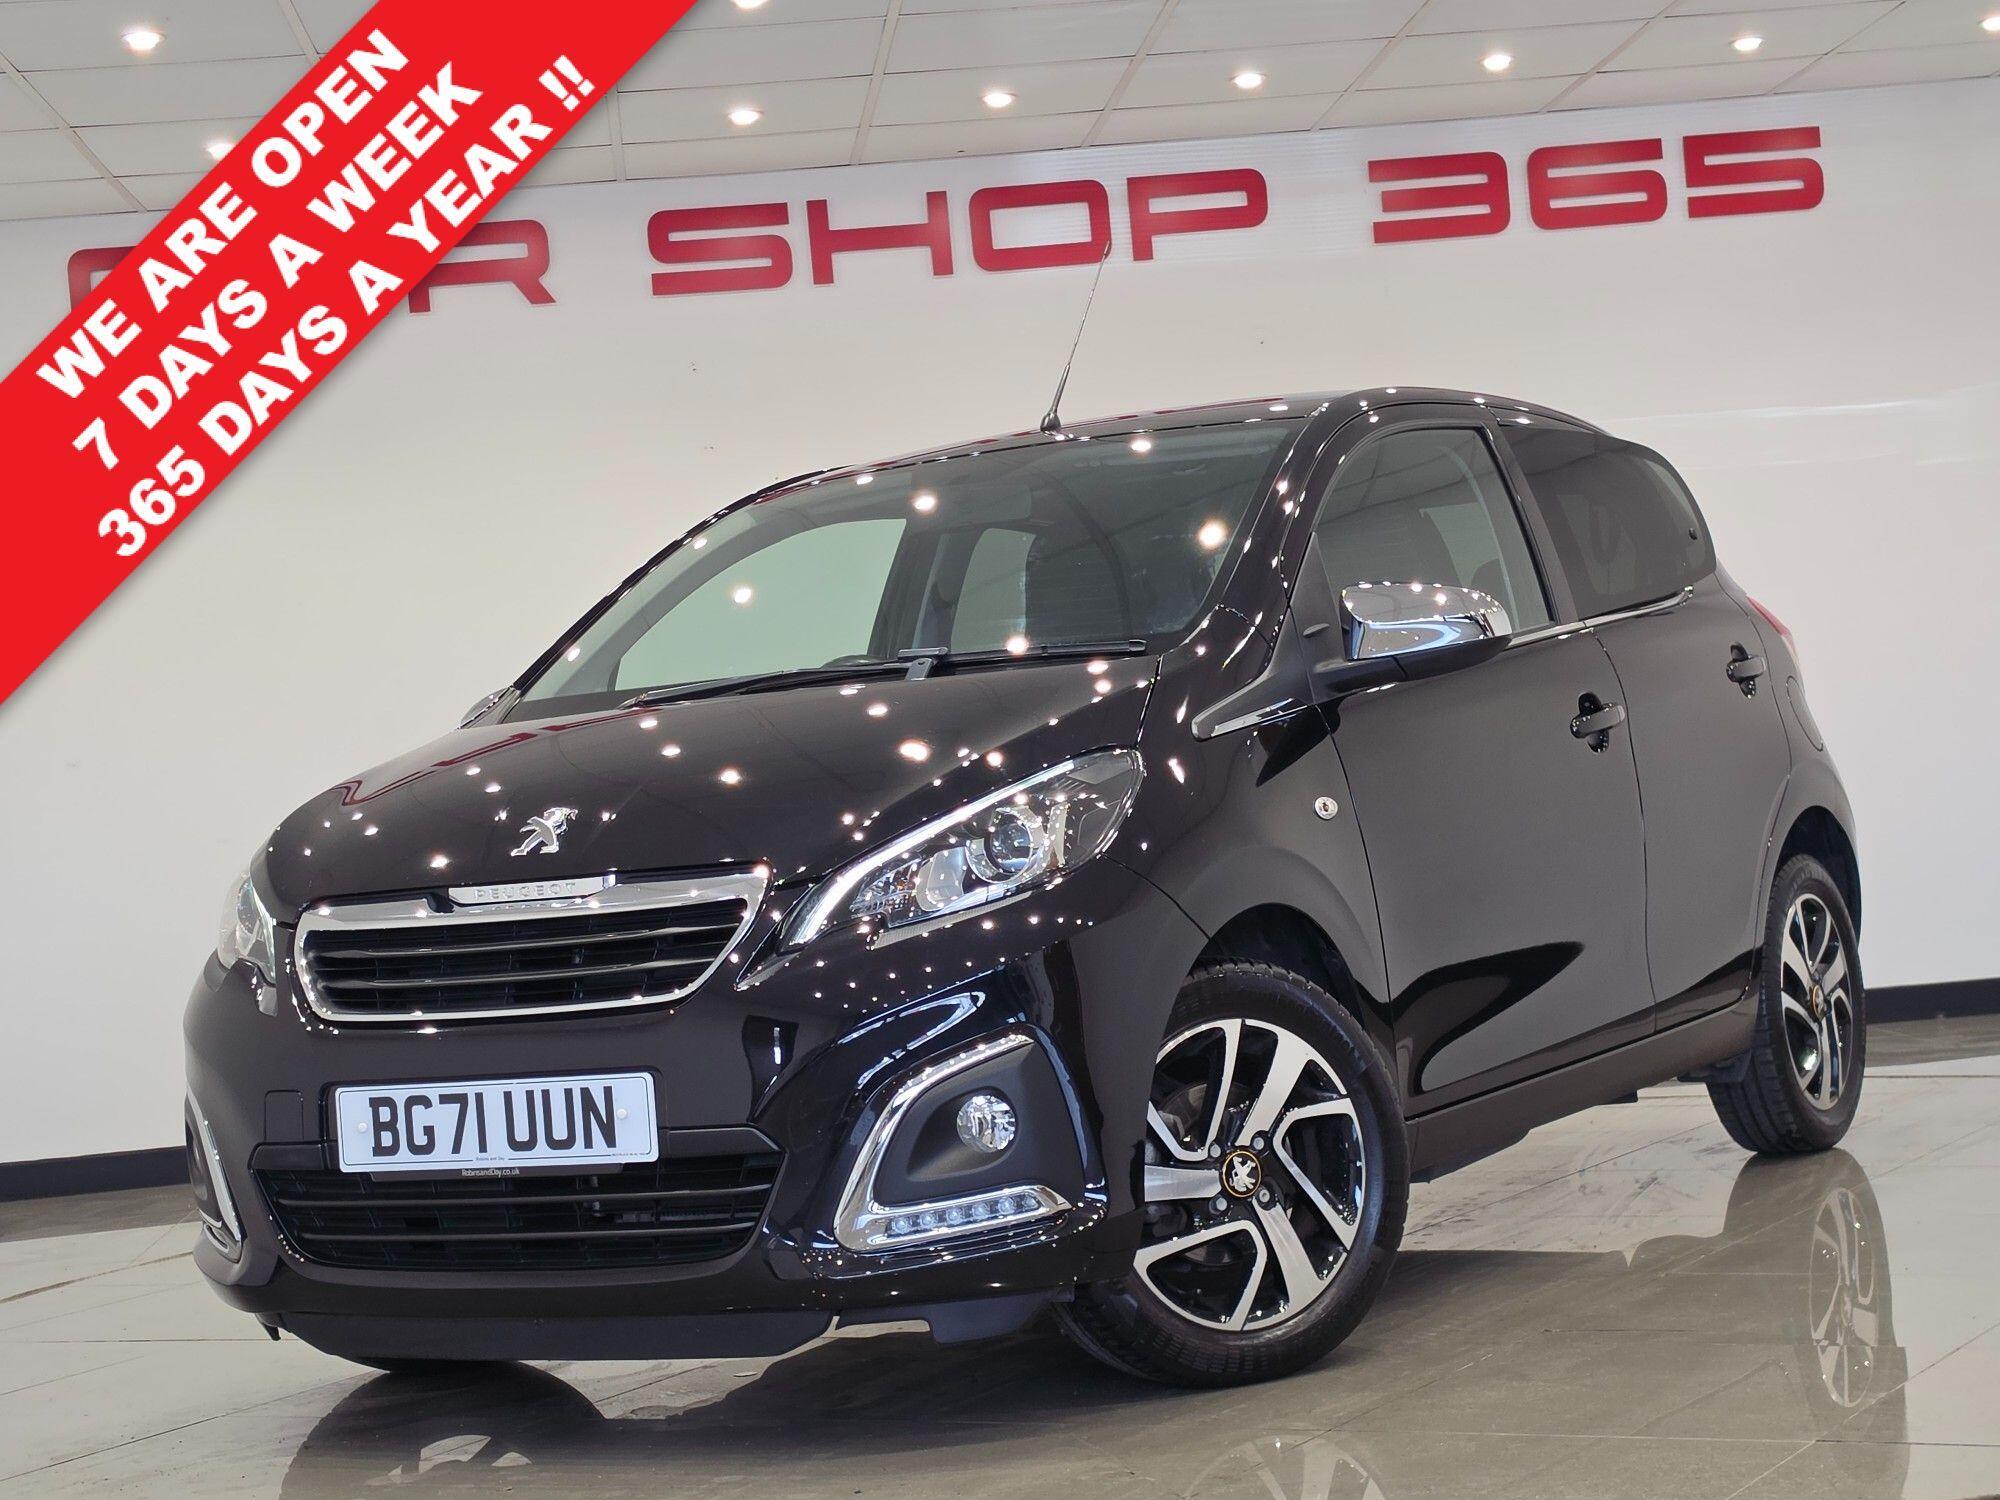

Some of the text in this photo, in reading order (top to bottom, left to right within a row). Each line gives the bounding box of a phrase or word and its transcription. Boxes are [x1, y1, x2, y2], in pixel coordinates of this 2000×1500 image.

[647, 168, 1268, 296] SHOP
[1368, 126, 1824, 244] 365
[474, 882, 576, 899] PEUGEOT
[368, 1085, 617, 1158] BG71 UUN
